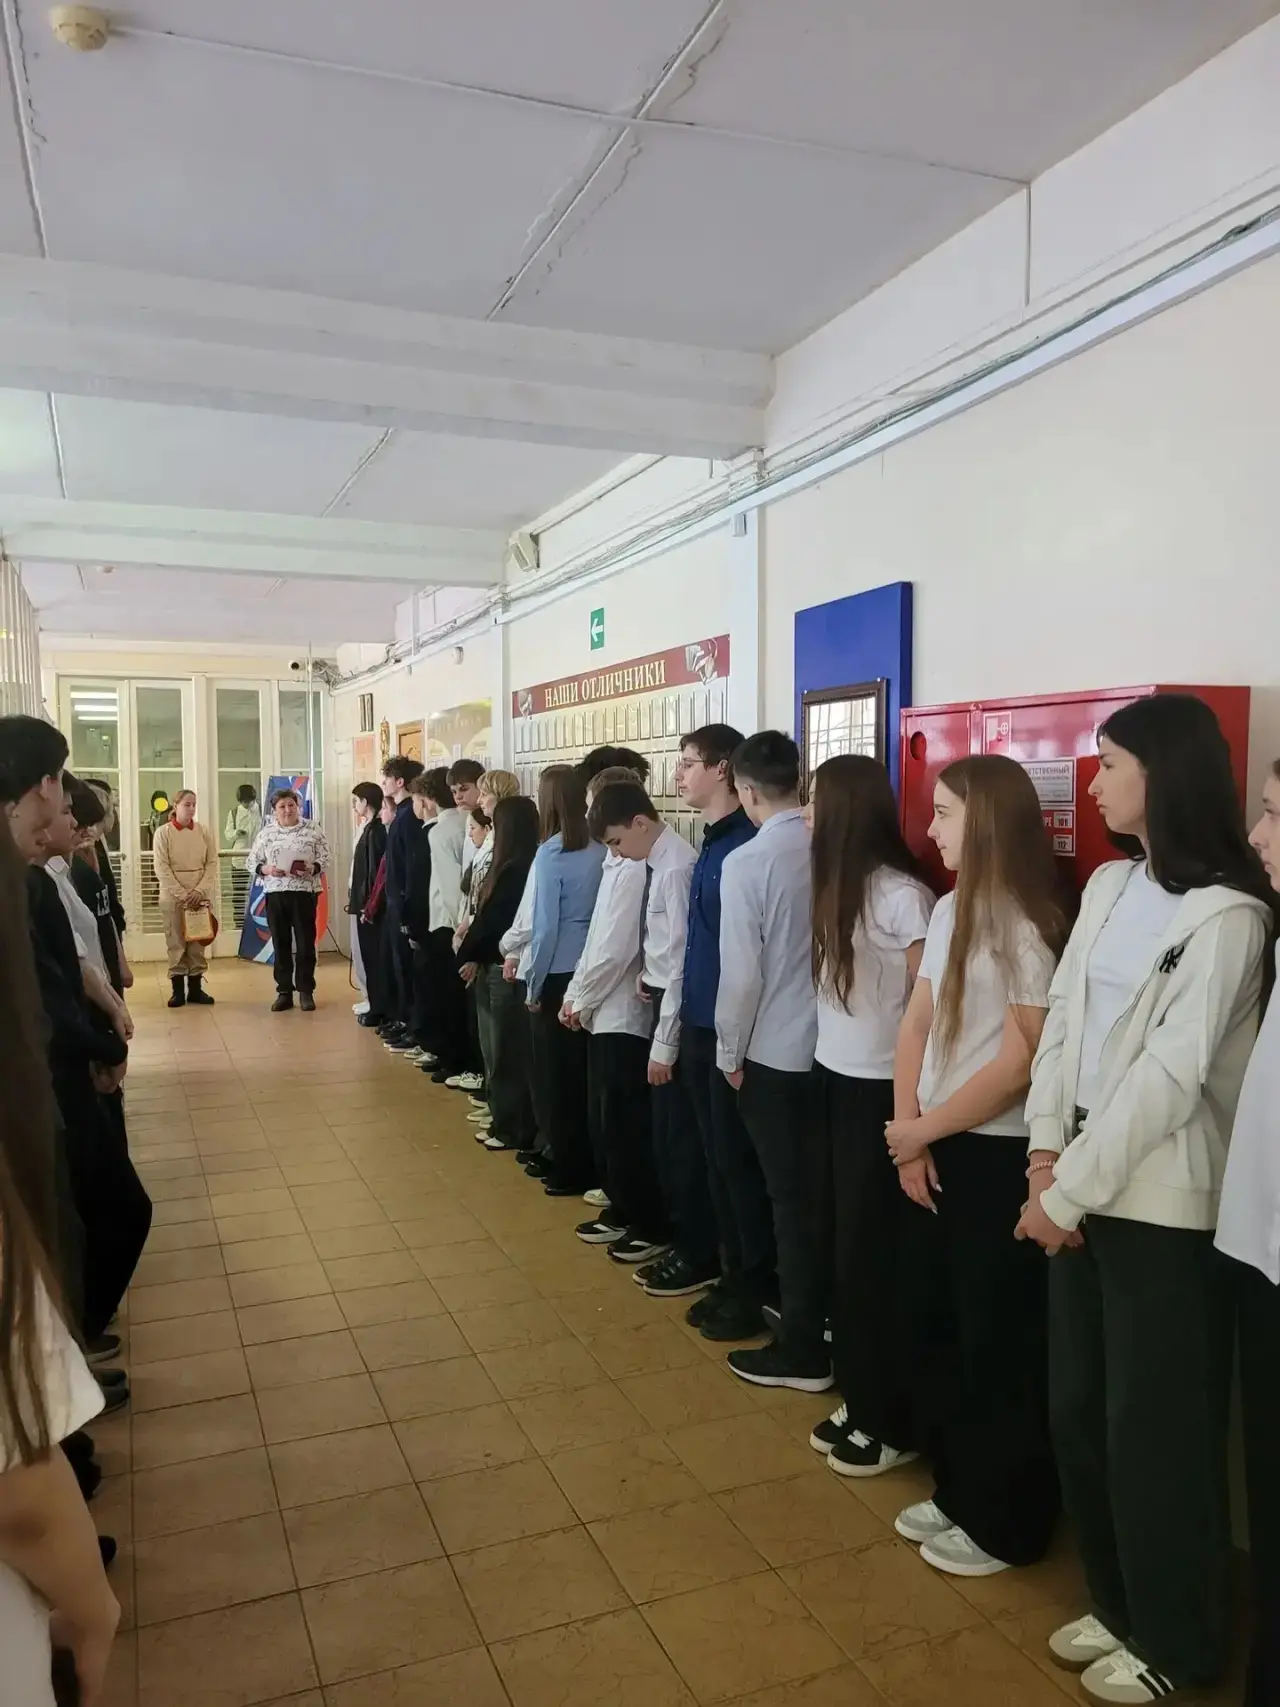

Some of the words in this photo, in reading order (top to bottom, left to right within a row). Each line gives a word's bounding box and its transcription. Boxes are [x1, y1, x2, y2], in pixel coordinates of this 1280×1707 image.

[545, 682, 579, 708] НАШИ
[581, 659, 666, 700] ОТЛИЧНИКИ
[1027, 764, 1070, 776] ЕТСТВЕННЫЙ
[1058, 840, 1067, 849] 112
